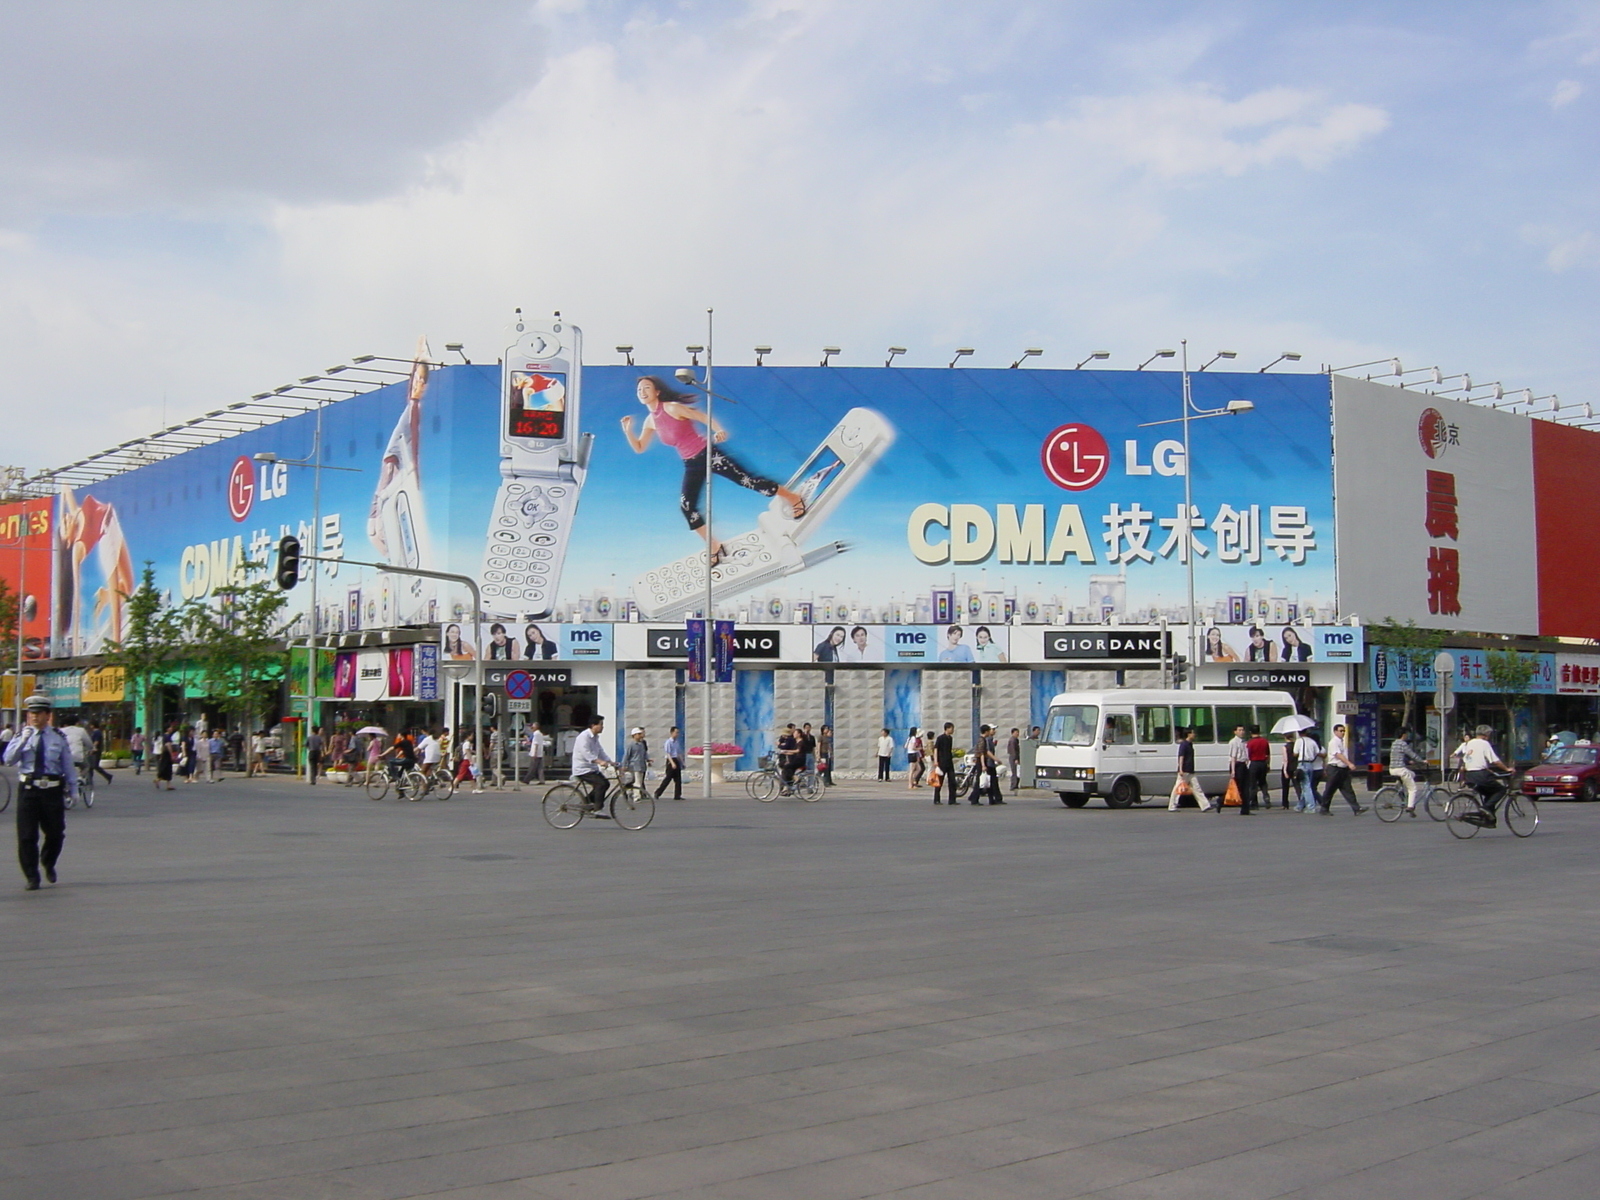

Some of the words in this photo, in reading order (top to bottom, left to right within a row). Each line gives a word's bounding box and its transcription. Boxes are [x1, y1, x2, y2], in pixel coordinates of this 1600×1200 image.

[516, 421, 558, 435] 16:20
[1434, 419, 1460, 446] 北京
[1125, 440, 1186, 476] LG
[260, 460, 287, 501] LG
[526, 503, 540, 512] OK
[907, 503, 1096, 566] CDMA
[1102, 502, 1318, 565] 技术创导
[180, 535, 246, 600] CDMA
[570, 629, 602, 642] me
[895, 632, 927, 644] me
[1324, 632, 1354, 645] me
[421, 646, 436, 699] 专修瑞士表
[1234, 674, 1306, 684] GIORDANO
[1376, 651, 1387, 687] 王府井
